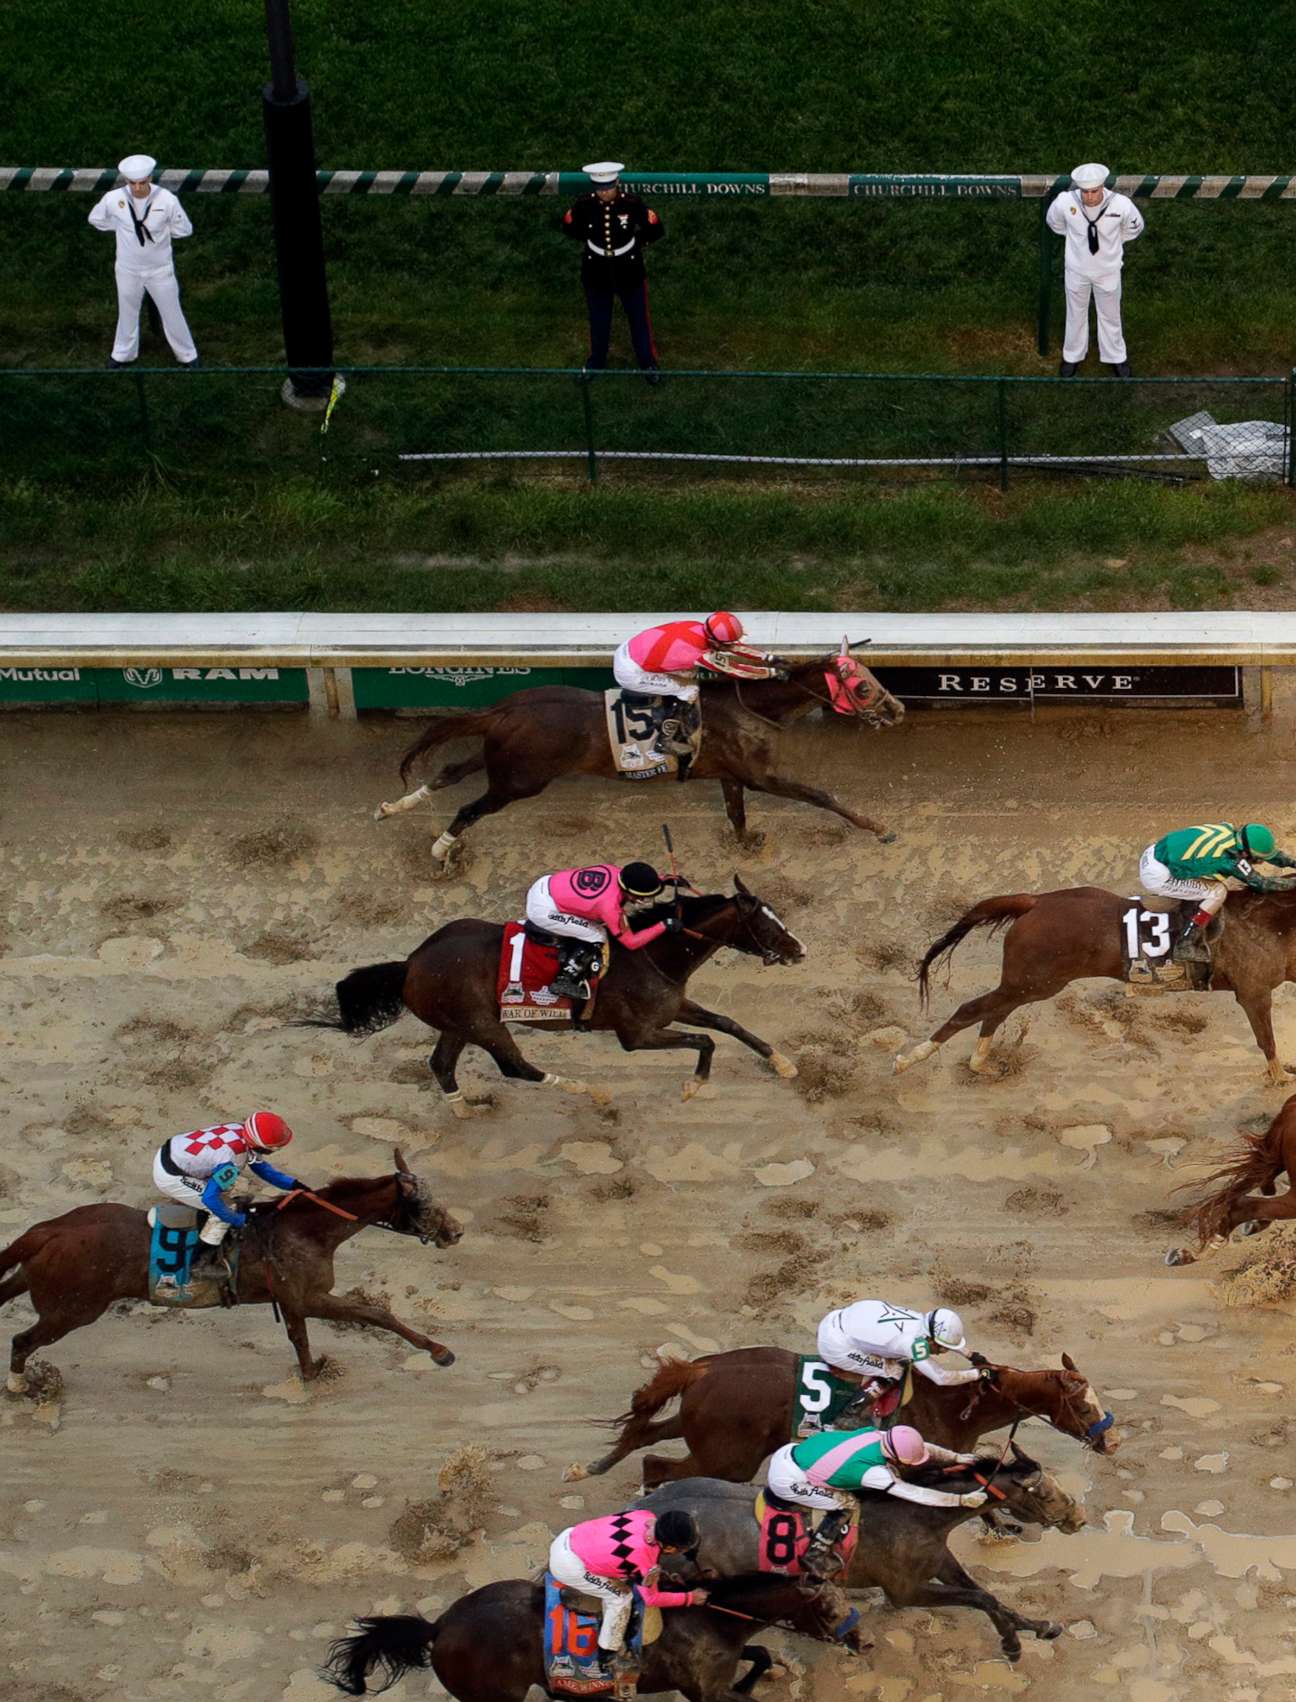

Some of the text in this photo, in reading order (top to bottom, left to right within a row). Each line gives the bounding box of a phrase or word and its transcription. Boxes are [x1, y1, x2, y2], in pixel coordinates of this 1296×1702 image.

[617, 183, 766, 195] HURCHILL DOWNS
[854, 184, 1017, 196] CHURCHILL DOWNS
[172, 668, 279, 680] RAM
[938, 674, 1133, 692] RESERVE
[611, 698, 655, 744] 15
[577, 870, 607, 893] B
[1122, 908, 1171, 959] 13
[509, 932, 527, 982] 1
[219, 1168, 234, 1183] 9
[156, 1227, 187, 1273] 9
[914, 1342, 927, 1358] 5
[800, 1361, 832, 1413] 5
[767, 1514, 797, 1566] 8
[549, 1604, 597, 1657] 16
